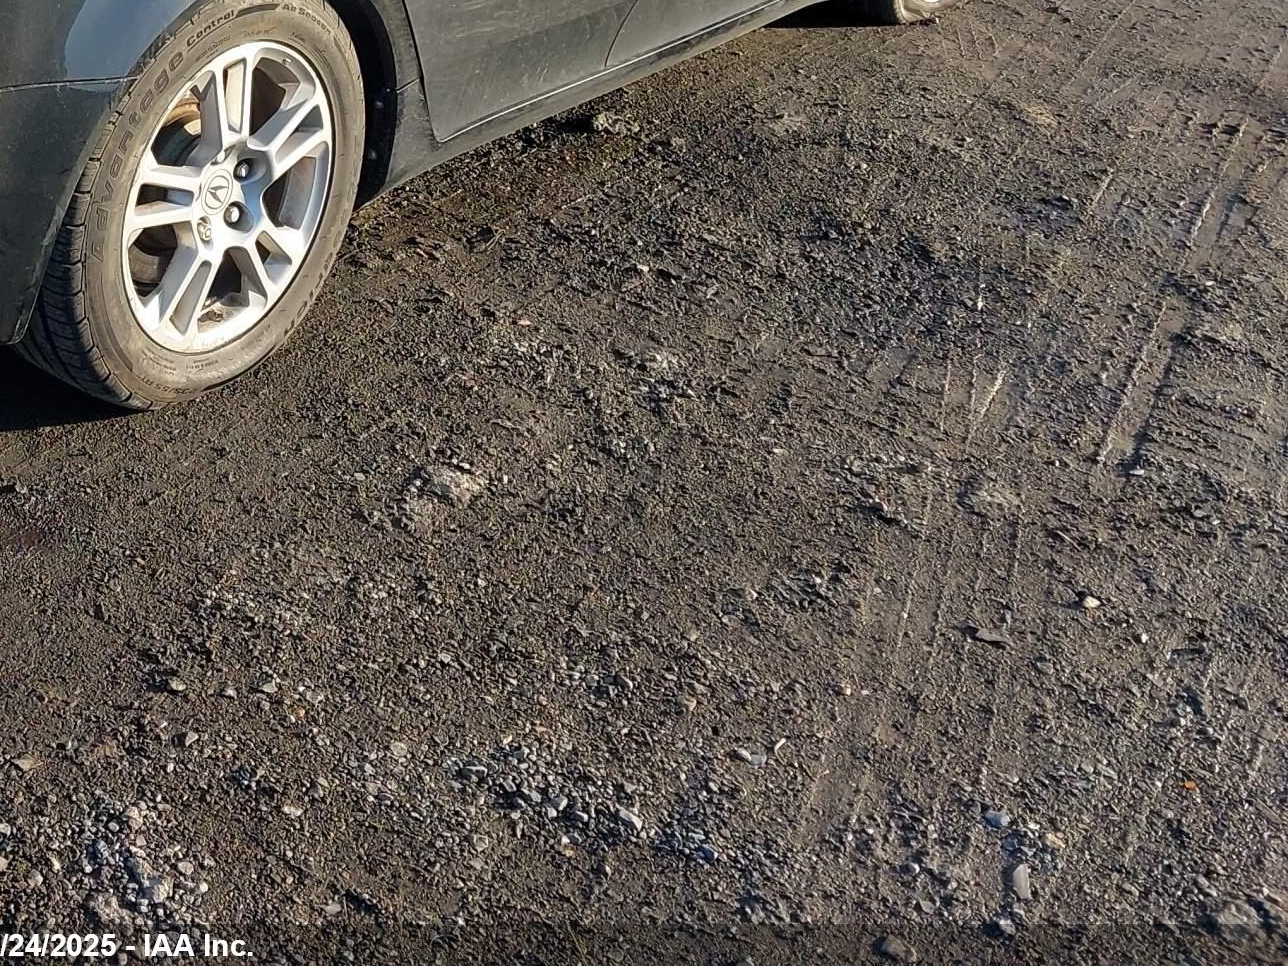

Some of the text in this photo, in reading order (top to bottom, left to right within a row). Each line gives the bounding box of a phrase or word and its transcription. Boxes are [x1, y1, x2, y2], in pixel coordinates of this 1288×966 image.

[281, 3, 297, 14] All
[91, 49, 185, 263] Advantage
[186, 9, 235, 48] Control
